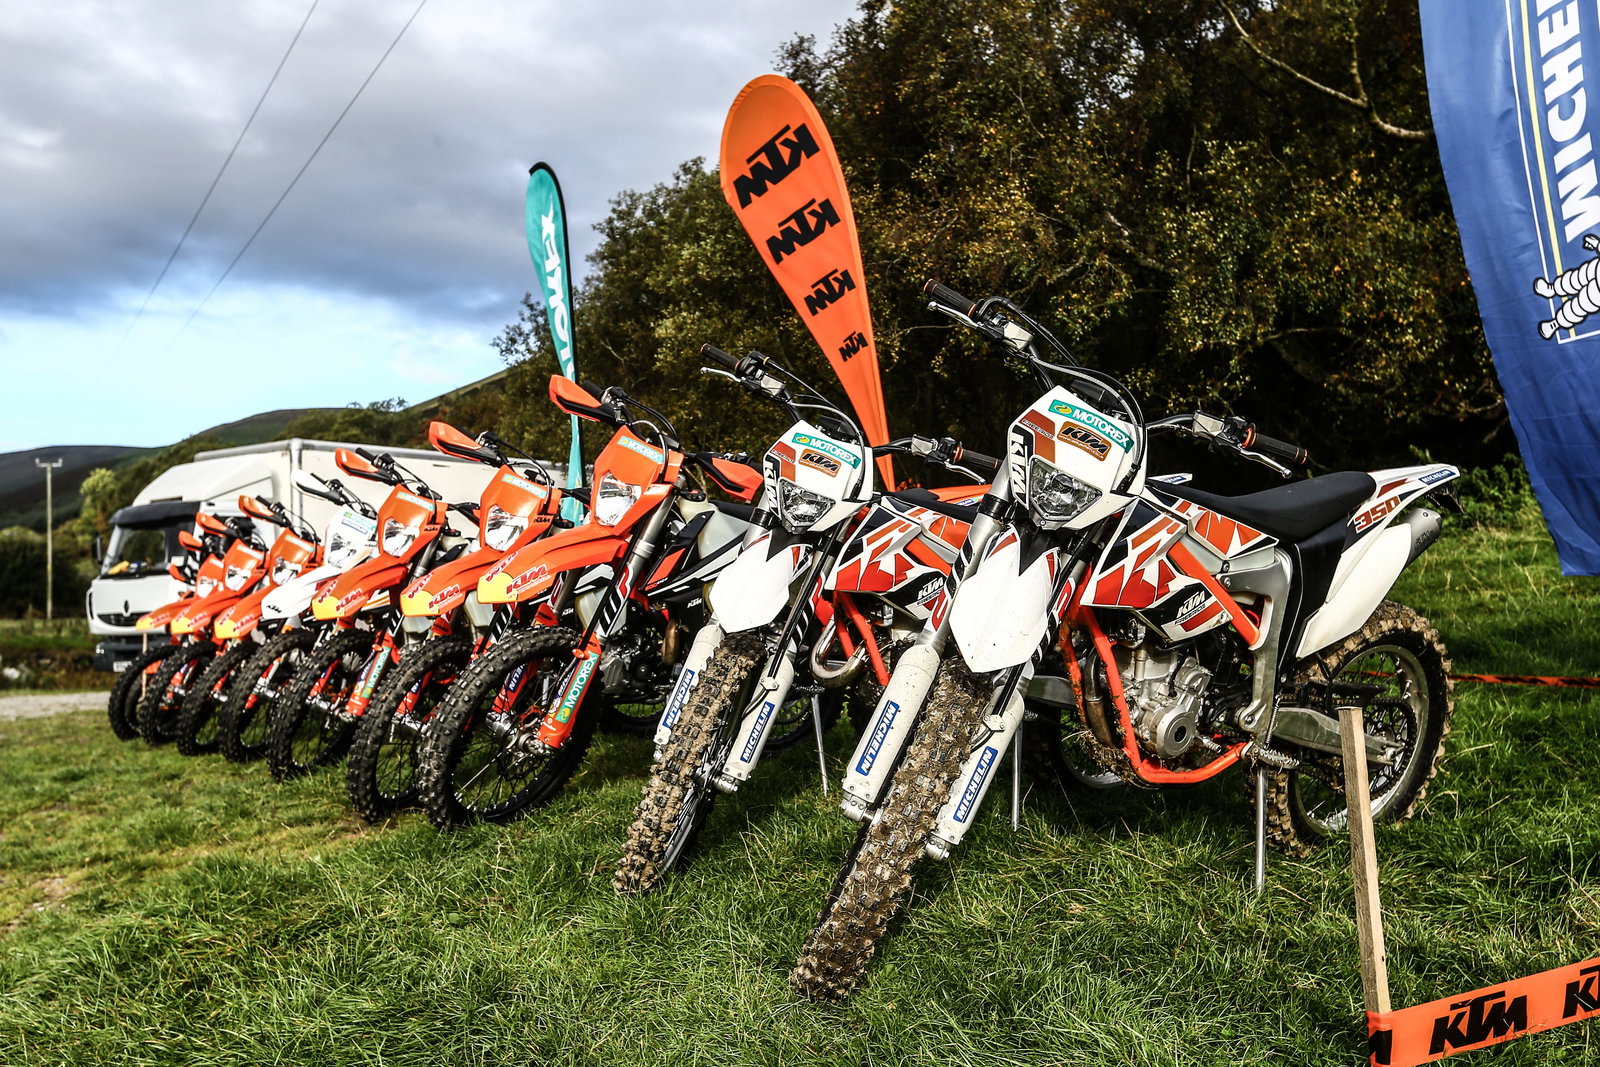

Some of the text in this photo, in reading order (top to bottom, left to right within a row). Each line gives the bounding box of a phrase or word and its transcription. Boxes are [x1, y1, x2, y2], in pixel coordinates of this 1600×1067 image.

[1061, 426, 1109, 454] KTM
[1072, 409, 1130, 447] MOTOREX
[801, 452, 839, 472] KTM
[809, 438, 857, 465] MOTOREX
[1353, 495, 1402, 534] 350
[428, 584, 461, 609] KTM
[506, 565, 548, 595] KTM
[917, 577, 944, 600] KTM
[1176, 590, 1206, 619] KTM
[567, 656, 598, 708] MOTOREX
[665, 670, 692, 727] MICHELIN
[743, 704, 772, 761] MICHELIN
[861, 703, 895, 771] MICHELIN
[957, 749, 993, 819] MICHELIN
[1429, 991, 1527, 1055] KTM
